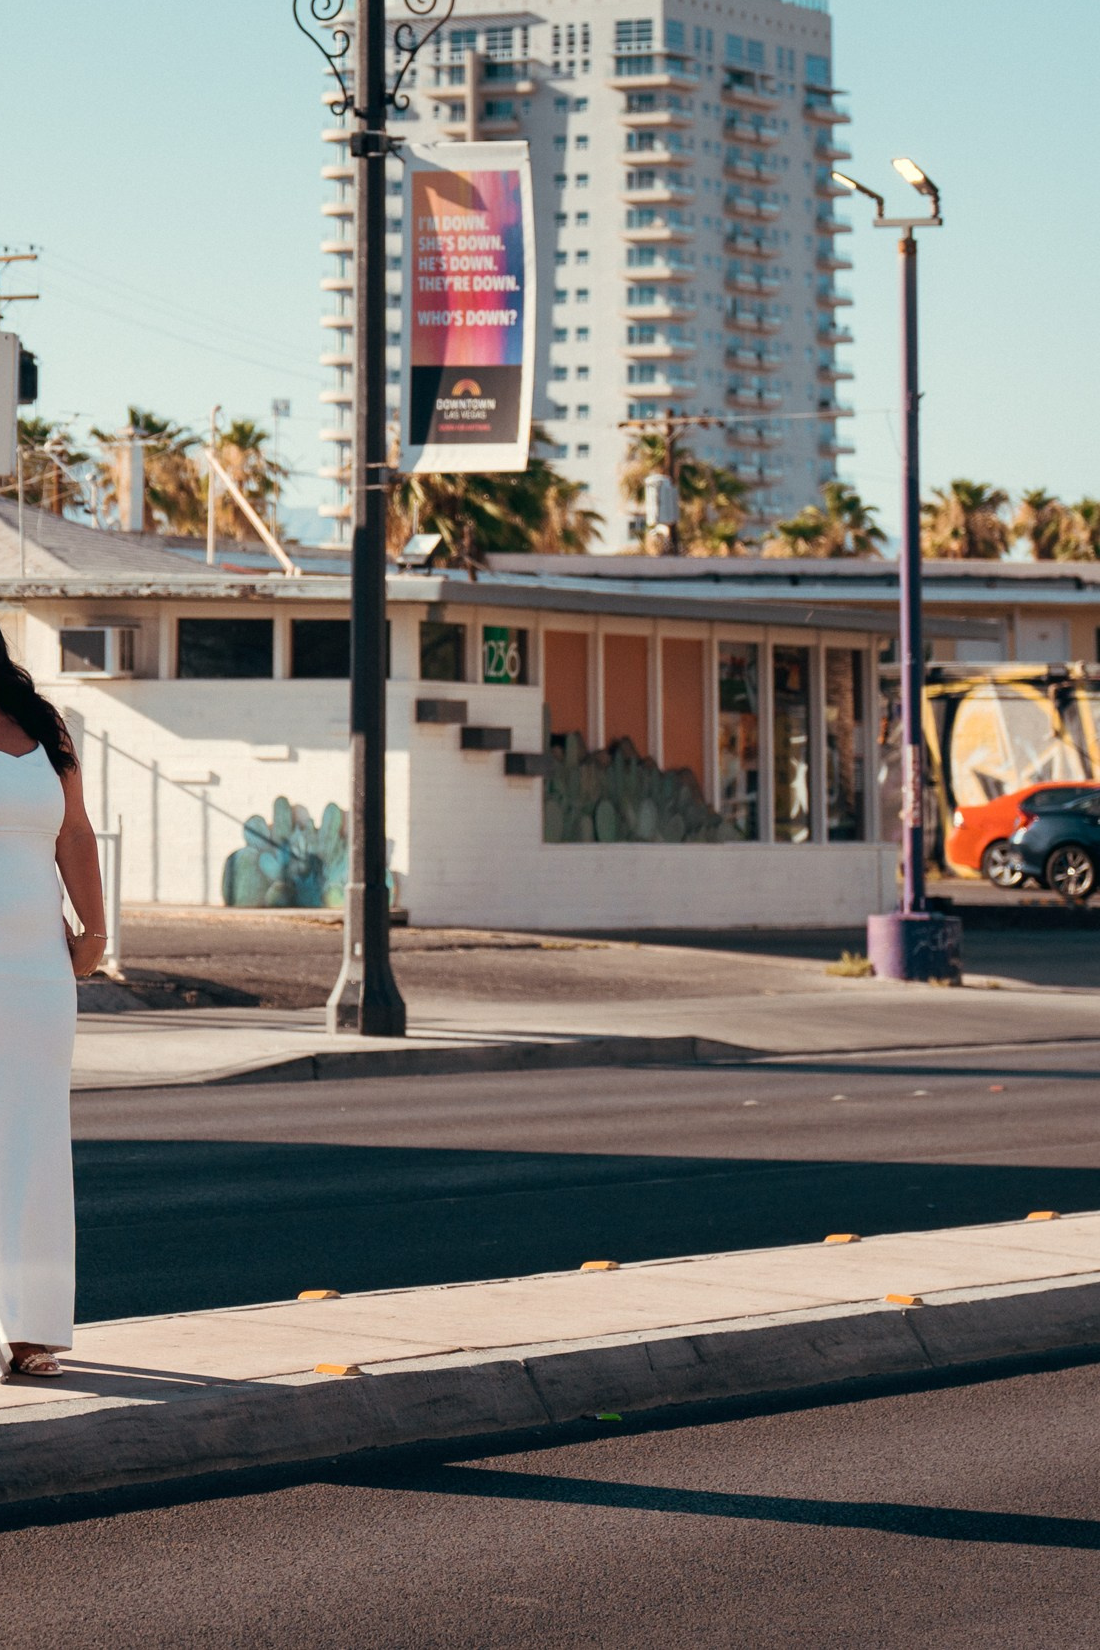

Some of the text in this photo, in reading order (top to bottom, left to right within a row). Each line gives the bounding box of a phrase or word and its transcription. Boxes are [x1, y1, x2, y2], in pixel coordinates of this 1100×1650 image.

[441, 215, 490, 231] DOWN.
[418, 234, 506, 251] SHE'S DOWN.
[418, 255, 498, 271] HE'S DOWN.
[417, 275, 521, 291] THEY'RE DOWN.
[417, 309, 518, 326] WHO'S DOWN?
[435, 398, 497, 410] DOWNTOWN
[443, 410, 488, 420] LAS VEGAS
